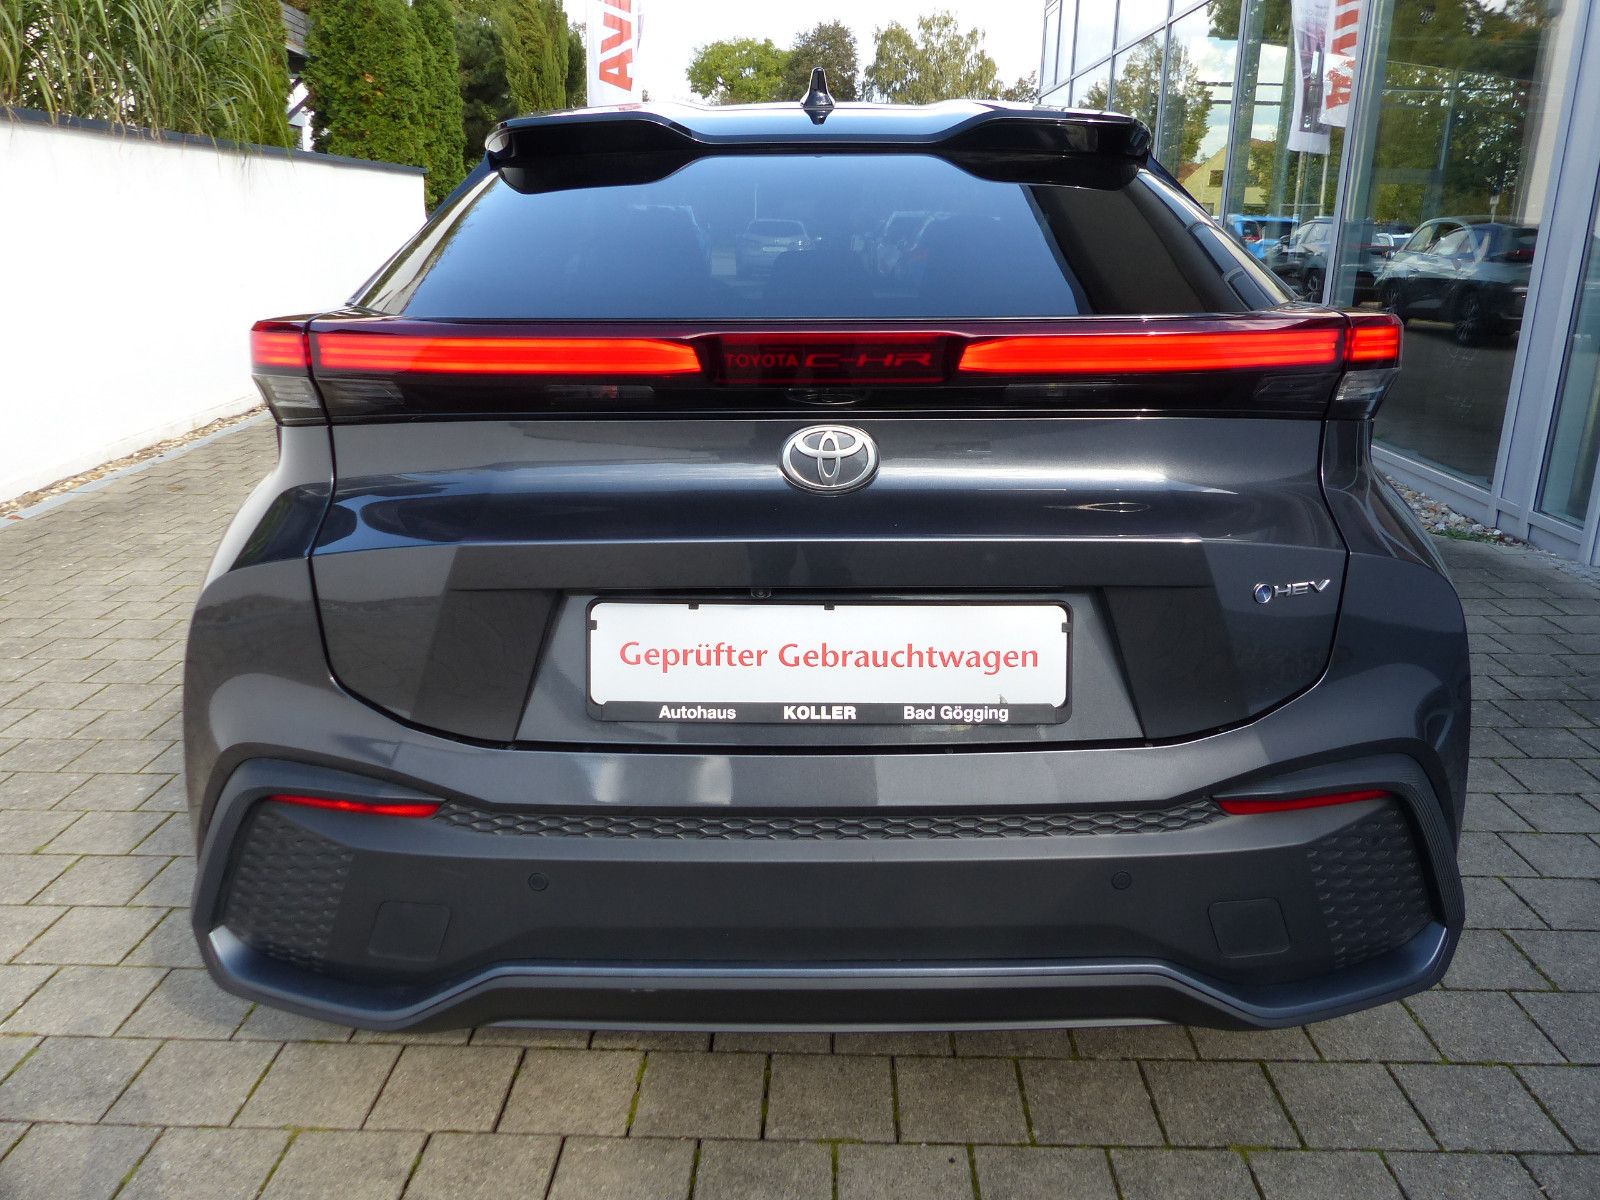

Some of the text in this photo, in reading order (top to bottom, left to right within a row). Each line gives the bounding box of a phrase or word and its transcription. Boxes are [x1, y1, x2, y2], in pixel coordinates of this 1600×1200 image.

[726, 353, 932, 368] TOYOTA C-HR
[1273, 579, 1331, 598] HEV
[619, 641, 1039, 676] Geprüfter Gebrauchtwagen
[658, 705, 1009, 722] Autohaus KOLLER Bad Gögging
